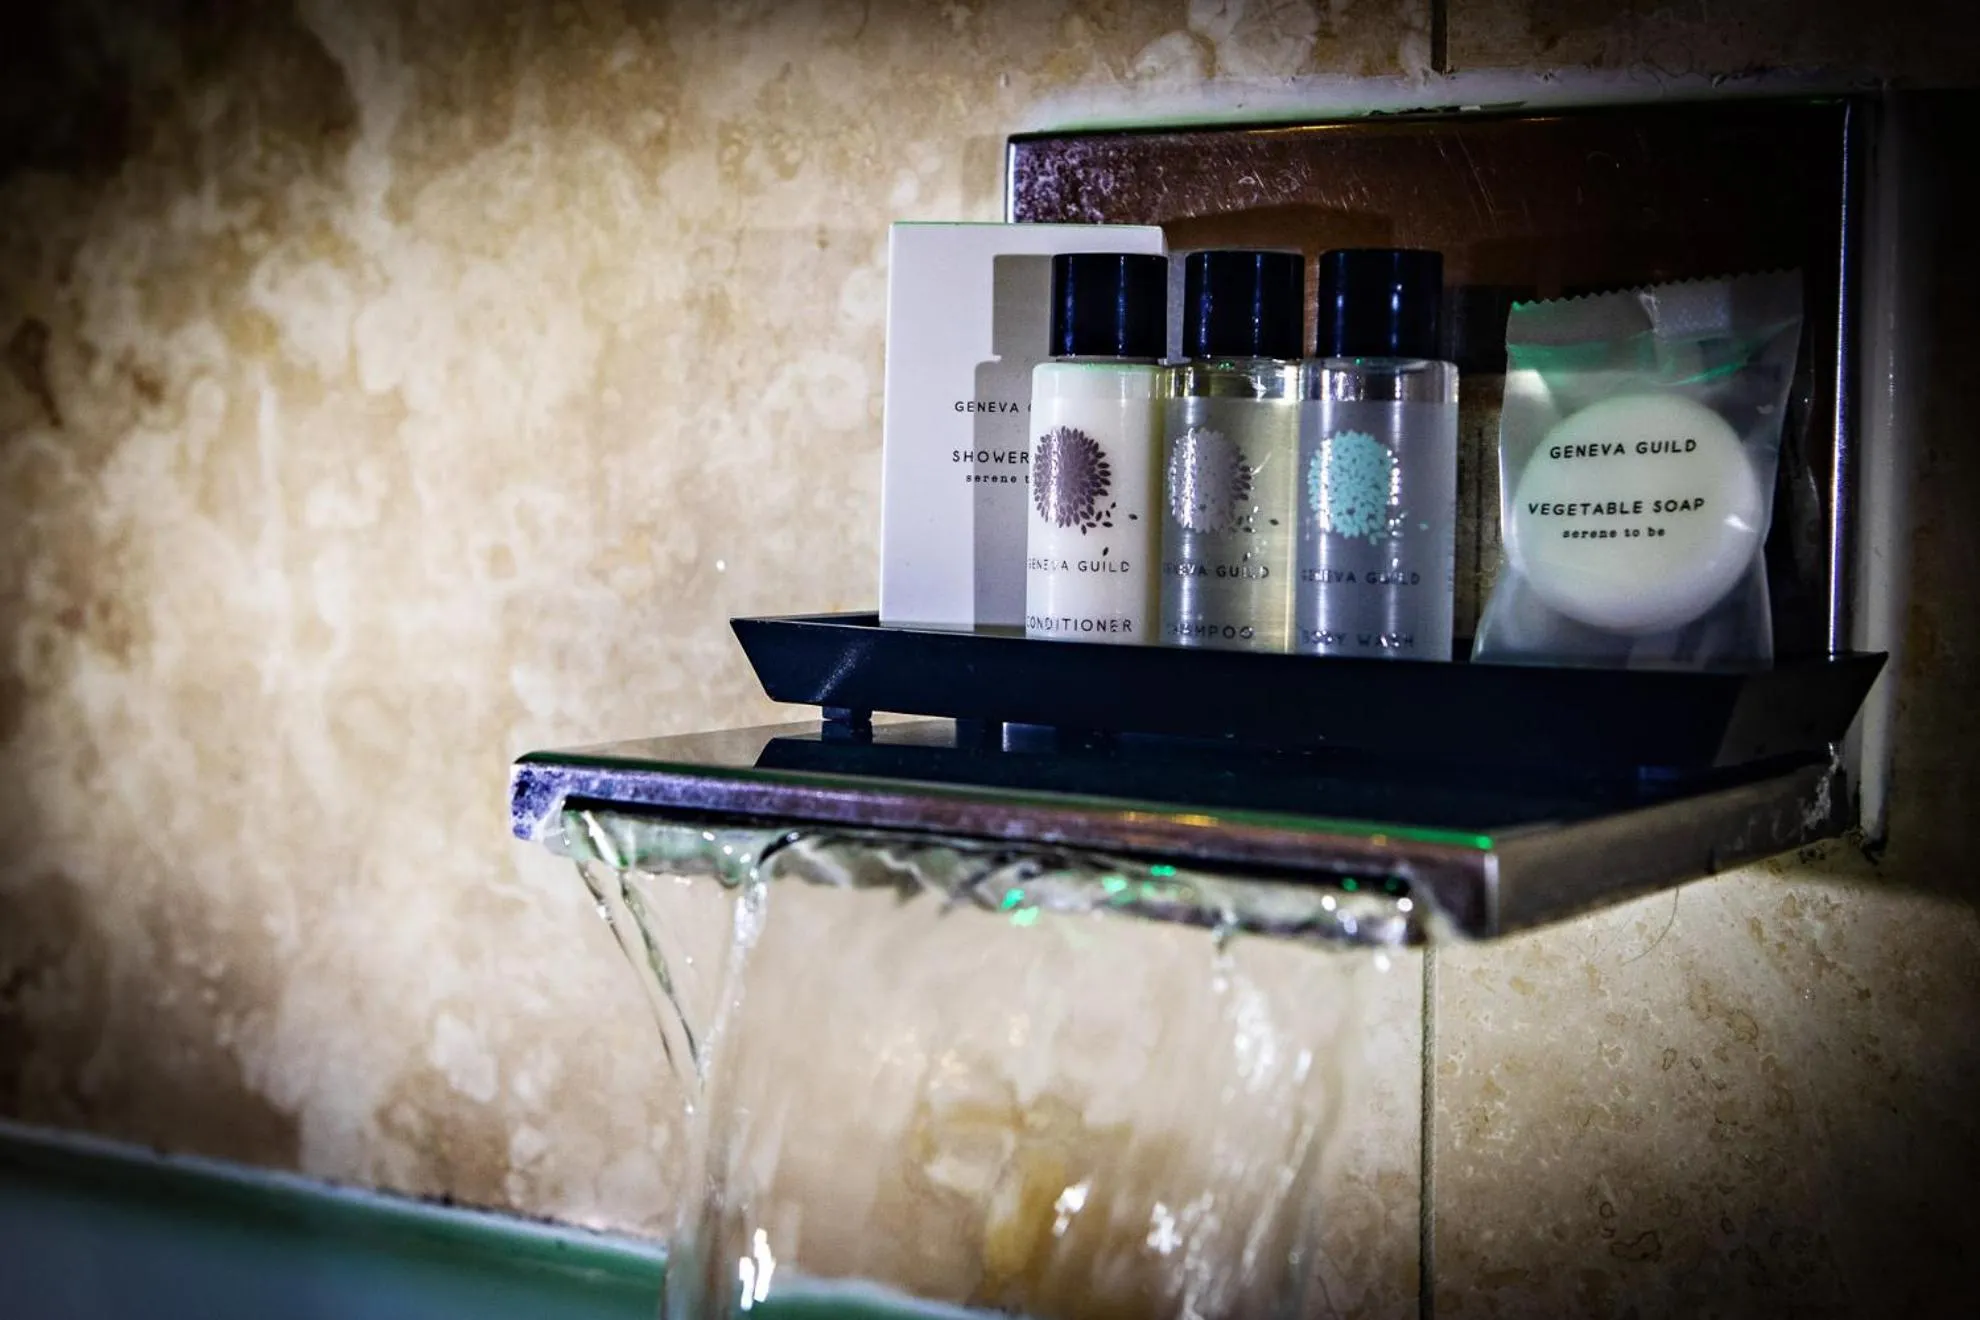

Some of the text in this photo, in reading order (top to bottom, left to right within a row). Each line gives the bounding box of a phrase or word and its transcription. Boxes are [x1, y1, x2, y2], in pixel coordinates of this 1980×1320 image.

[954, 400, 1019, 413] GENEVA
[1549, 438, 1698, 460] GENEVA GUILD
[952, 450, 1029, 464] SHOWER
[965, 474, 1018, 484] serene
[1528, 497, 1705, 516] VEGETABLE SOAP
[1562, 527, 1666, 539] serene to be
[1077, 560, 1130, 573] GUILD
